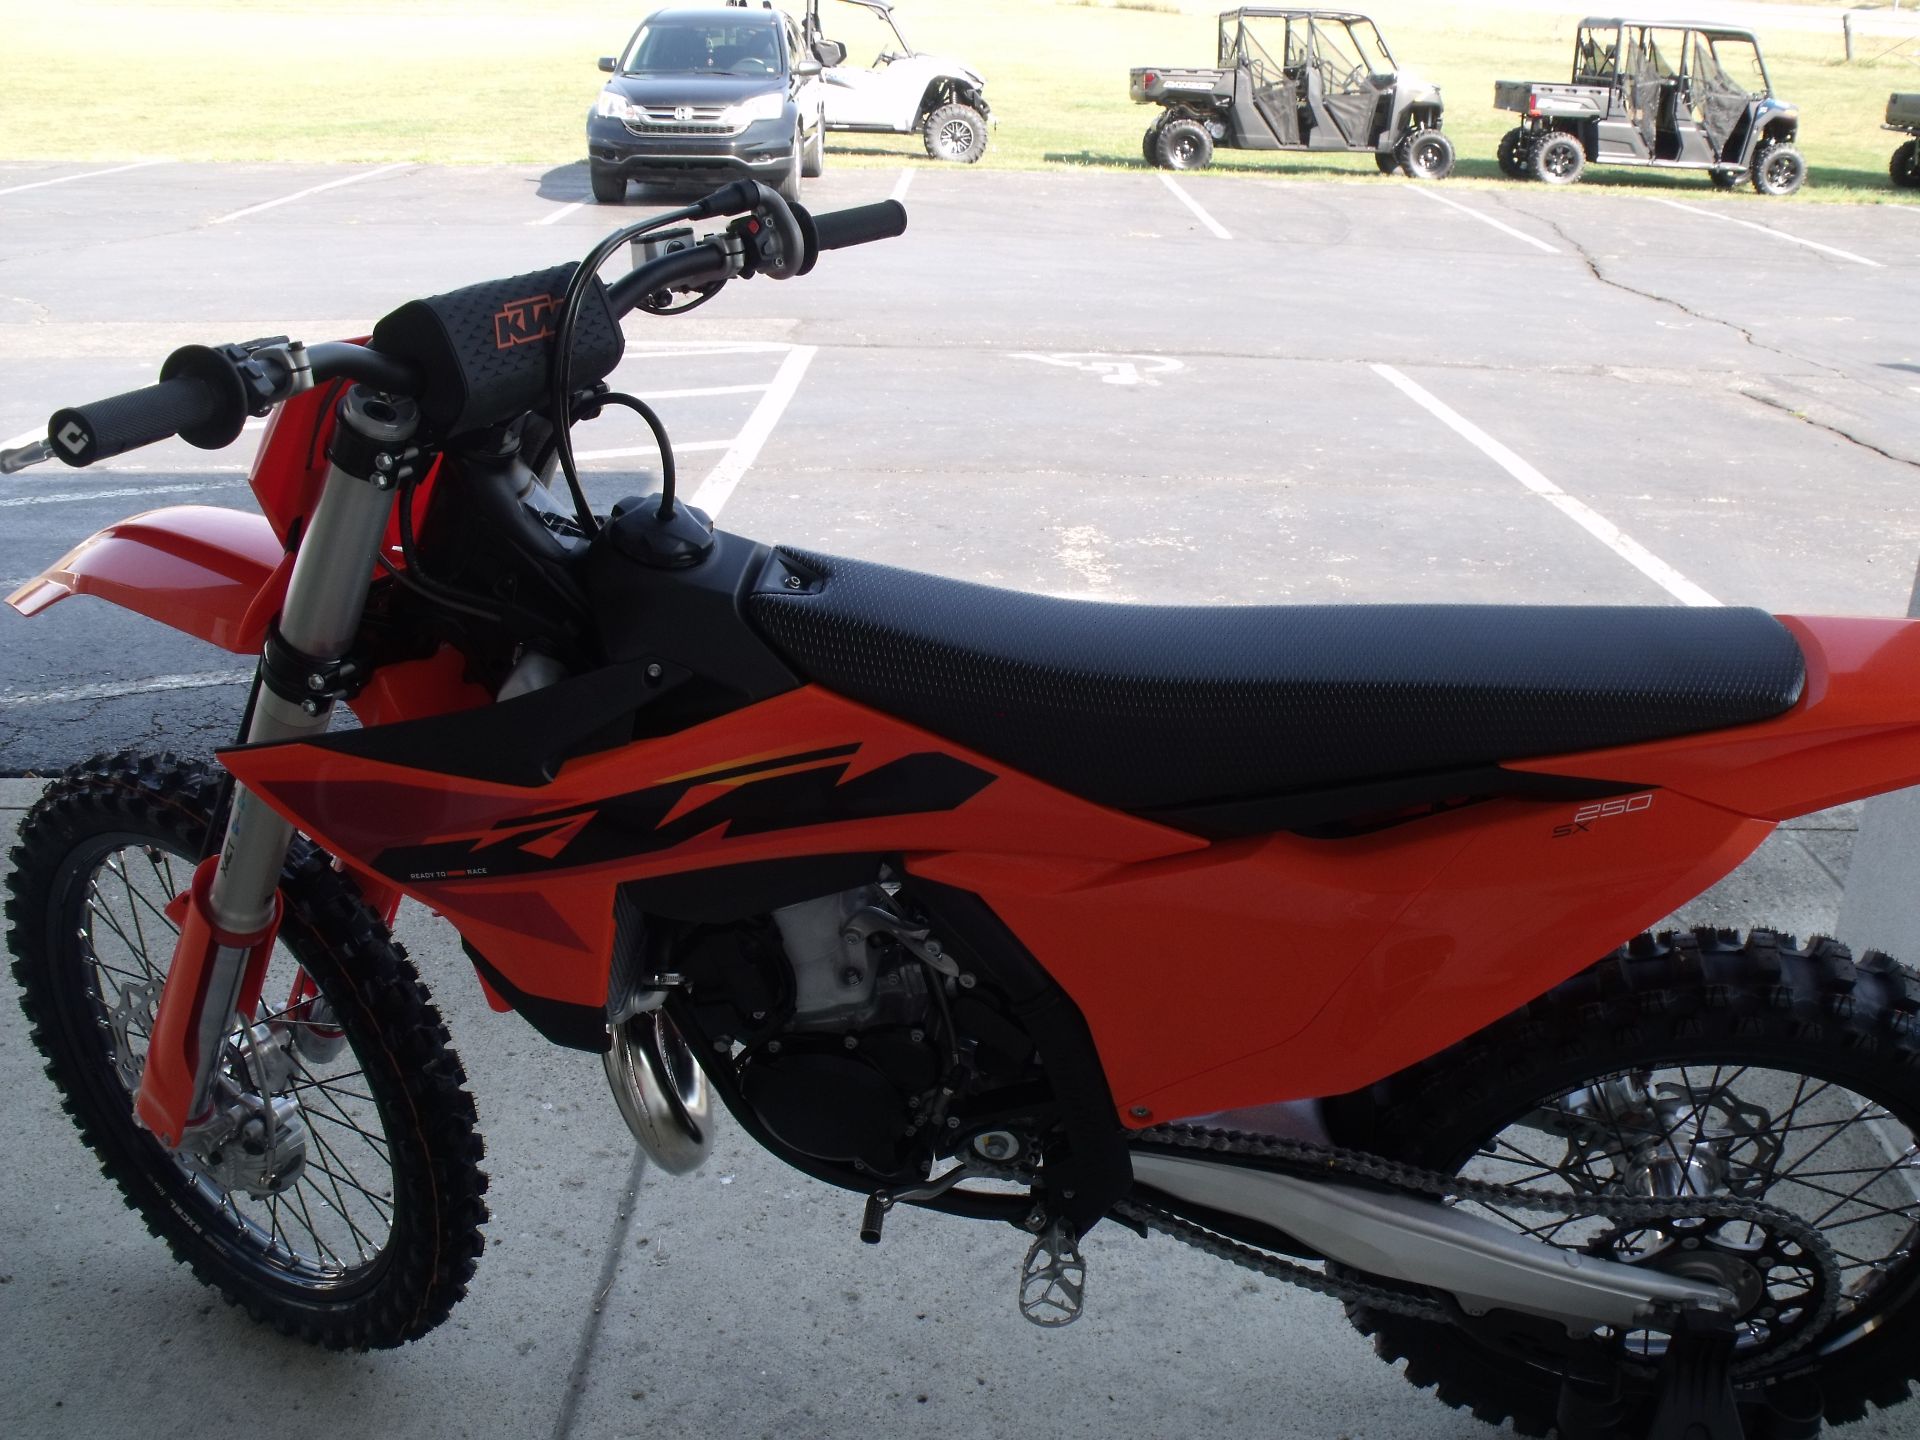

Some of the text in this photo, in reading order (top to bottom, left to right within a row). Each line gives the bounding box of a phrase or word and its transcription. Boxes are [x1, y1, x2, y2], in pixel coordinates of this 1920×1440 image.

[1574, 794, 1653, 822] 250
[1552, 820, 1591, 839] SX
[410, 872, 434, 880] READY
[466, 867, 488, 875] RACE
